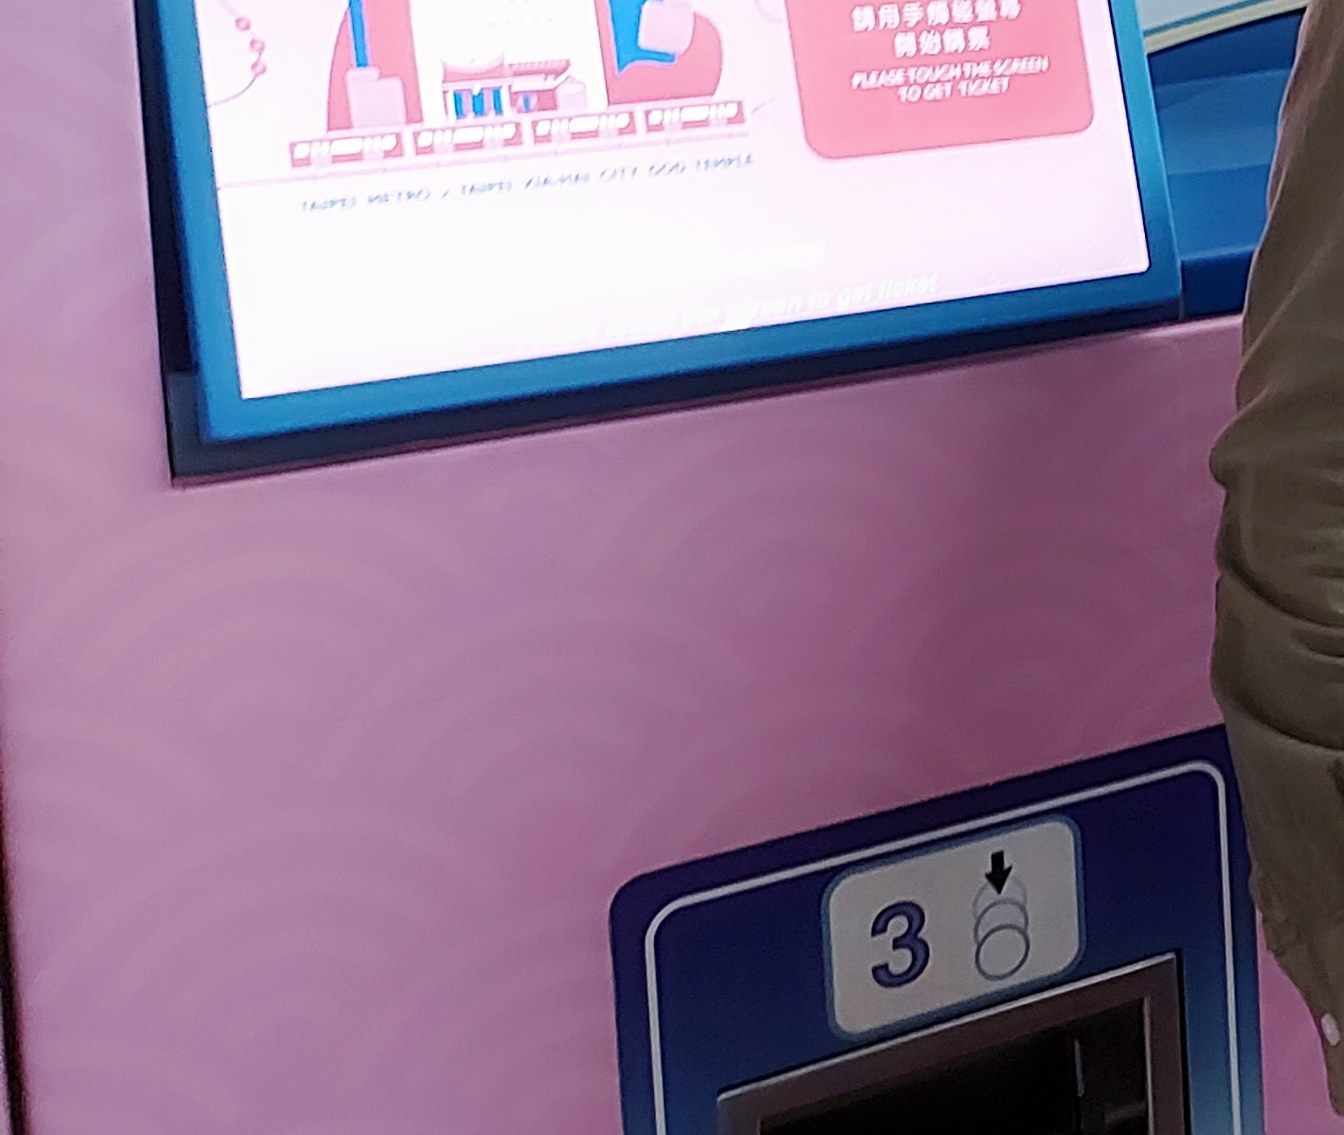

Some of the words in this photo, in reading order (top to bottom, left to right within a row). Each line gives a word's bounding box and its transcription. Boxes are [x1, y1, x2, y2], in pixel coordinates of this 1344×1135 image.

[851, 67, 907, 90] PLEASE
[907, 63, 962, 85] TOUCH
[963, 59, 992, 79] THE
[993, 55, 1050, 76] SCREEN
[897, 84, 922, 104] TO
[923, 81, 954, 102] GET
[957, 75, 1011, 98] TICKET
[869, 900, 931, 990] 3
